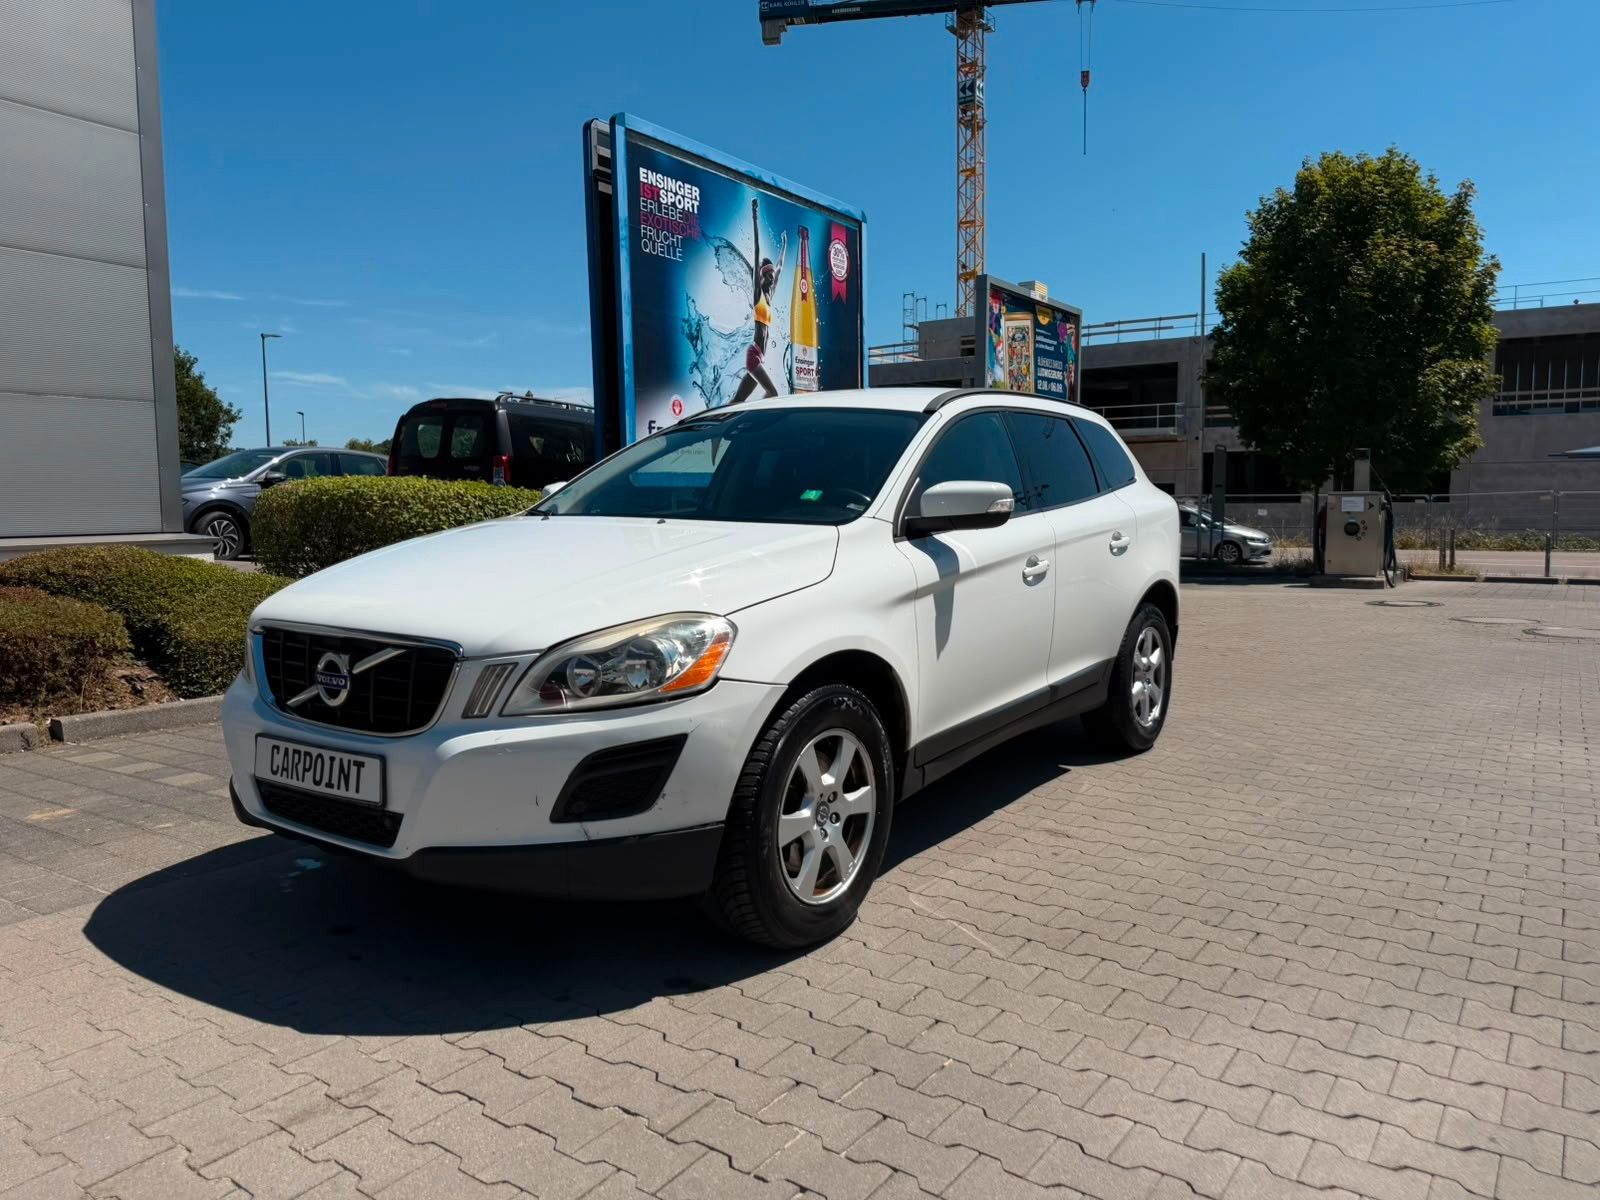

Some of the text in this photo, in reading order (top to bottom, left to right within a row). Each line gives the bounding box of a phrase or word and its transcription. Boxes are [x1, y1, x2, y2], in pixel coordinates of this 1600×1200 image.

[640, 167, 700, 201] ENSINGER
[640, 197, 683, 223] ERLEBE
[659, 189, 700, 214] SPORT
[640, 212, 700, 241] EXOTISCHE
[641, 225, 683, 248] FRUCHT
[641, 239, 683, 262] QUELLE
[796, 366, 815, 377] SPORT
[317, 674, 346, 686] VOLVO
[270, 745, 365, 794] CARPOINT
